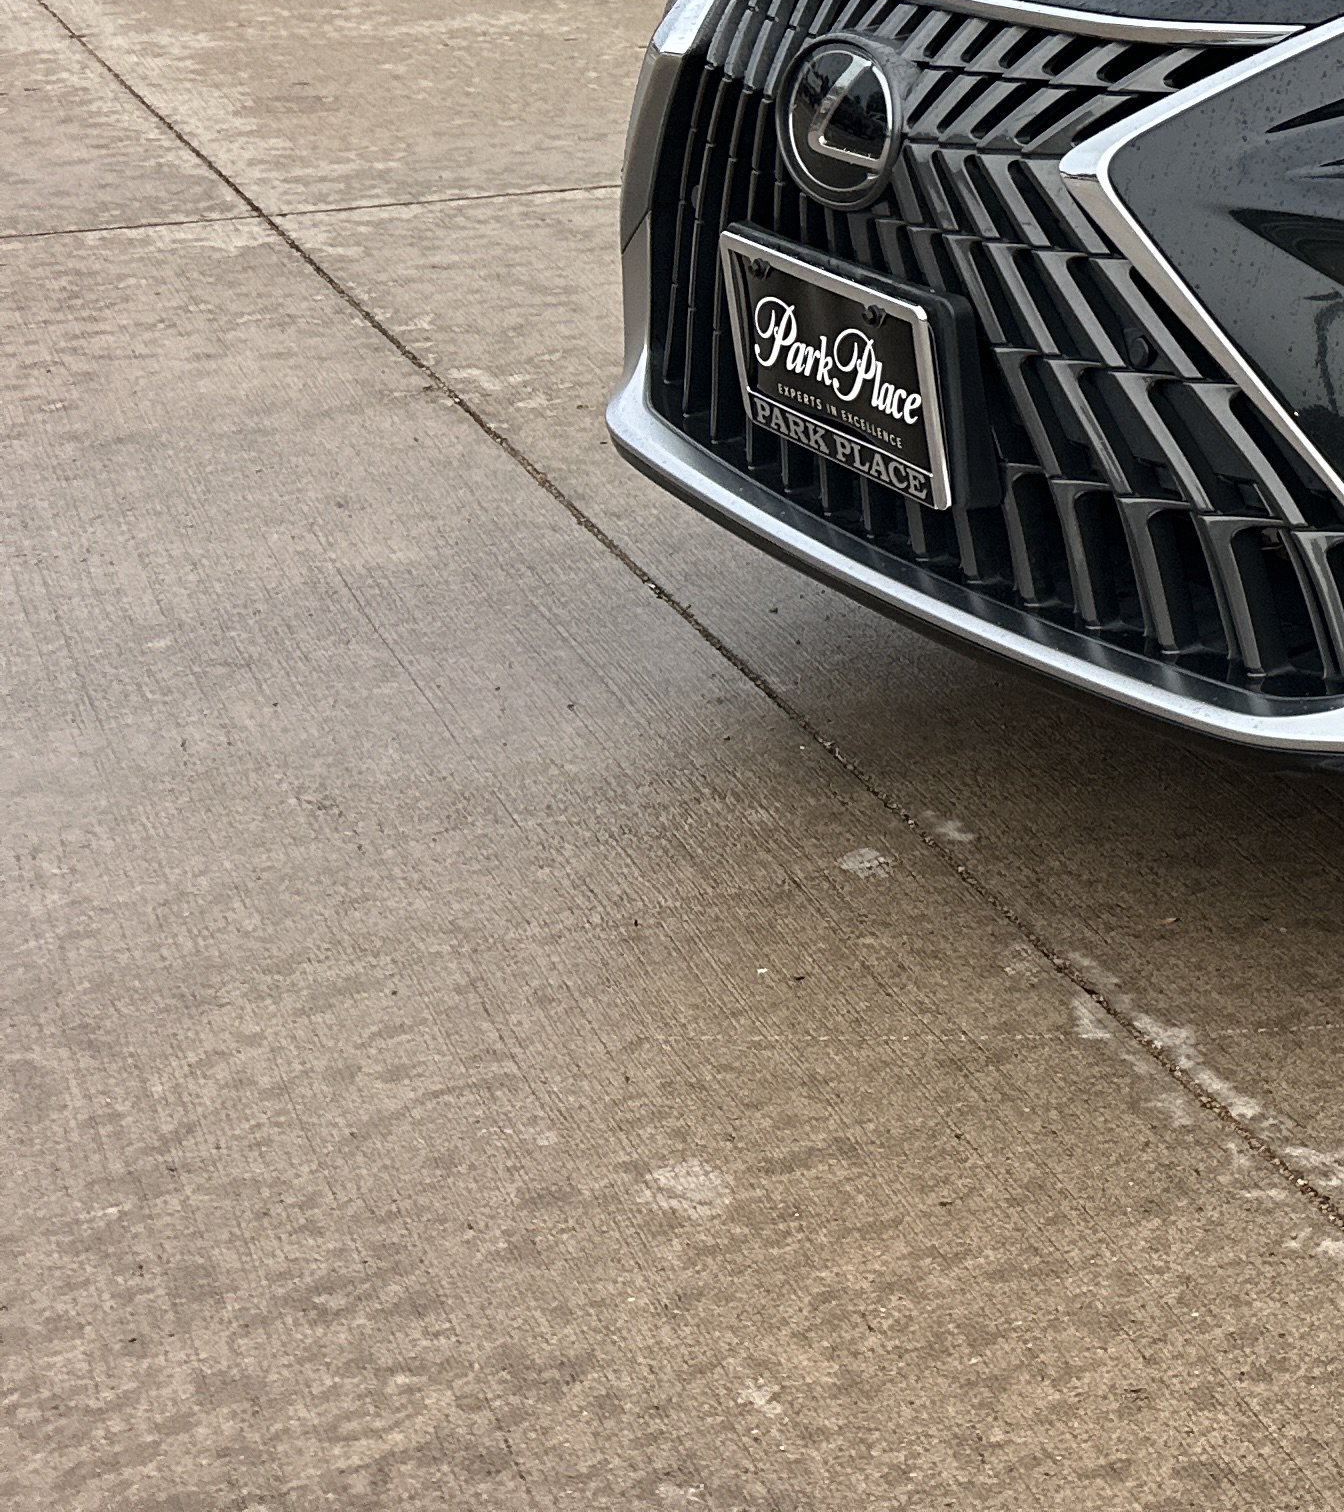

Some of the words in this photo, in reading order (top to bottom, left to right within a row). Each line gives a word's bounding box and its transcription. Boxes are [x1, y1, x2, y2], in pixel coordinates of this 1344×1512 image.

[755, 296, 833, 386] Park
[833, 328, 922, 424] Place
[755, 398, 829, 454] PARK
[836, 437, 927, 499] PLACE
[778, 383, 822, 410] EXPERTS
[826, 403, 838, 417] IN
[840, 409, 903, 449] EXCELLENCE
